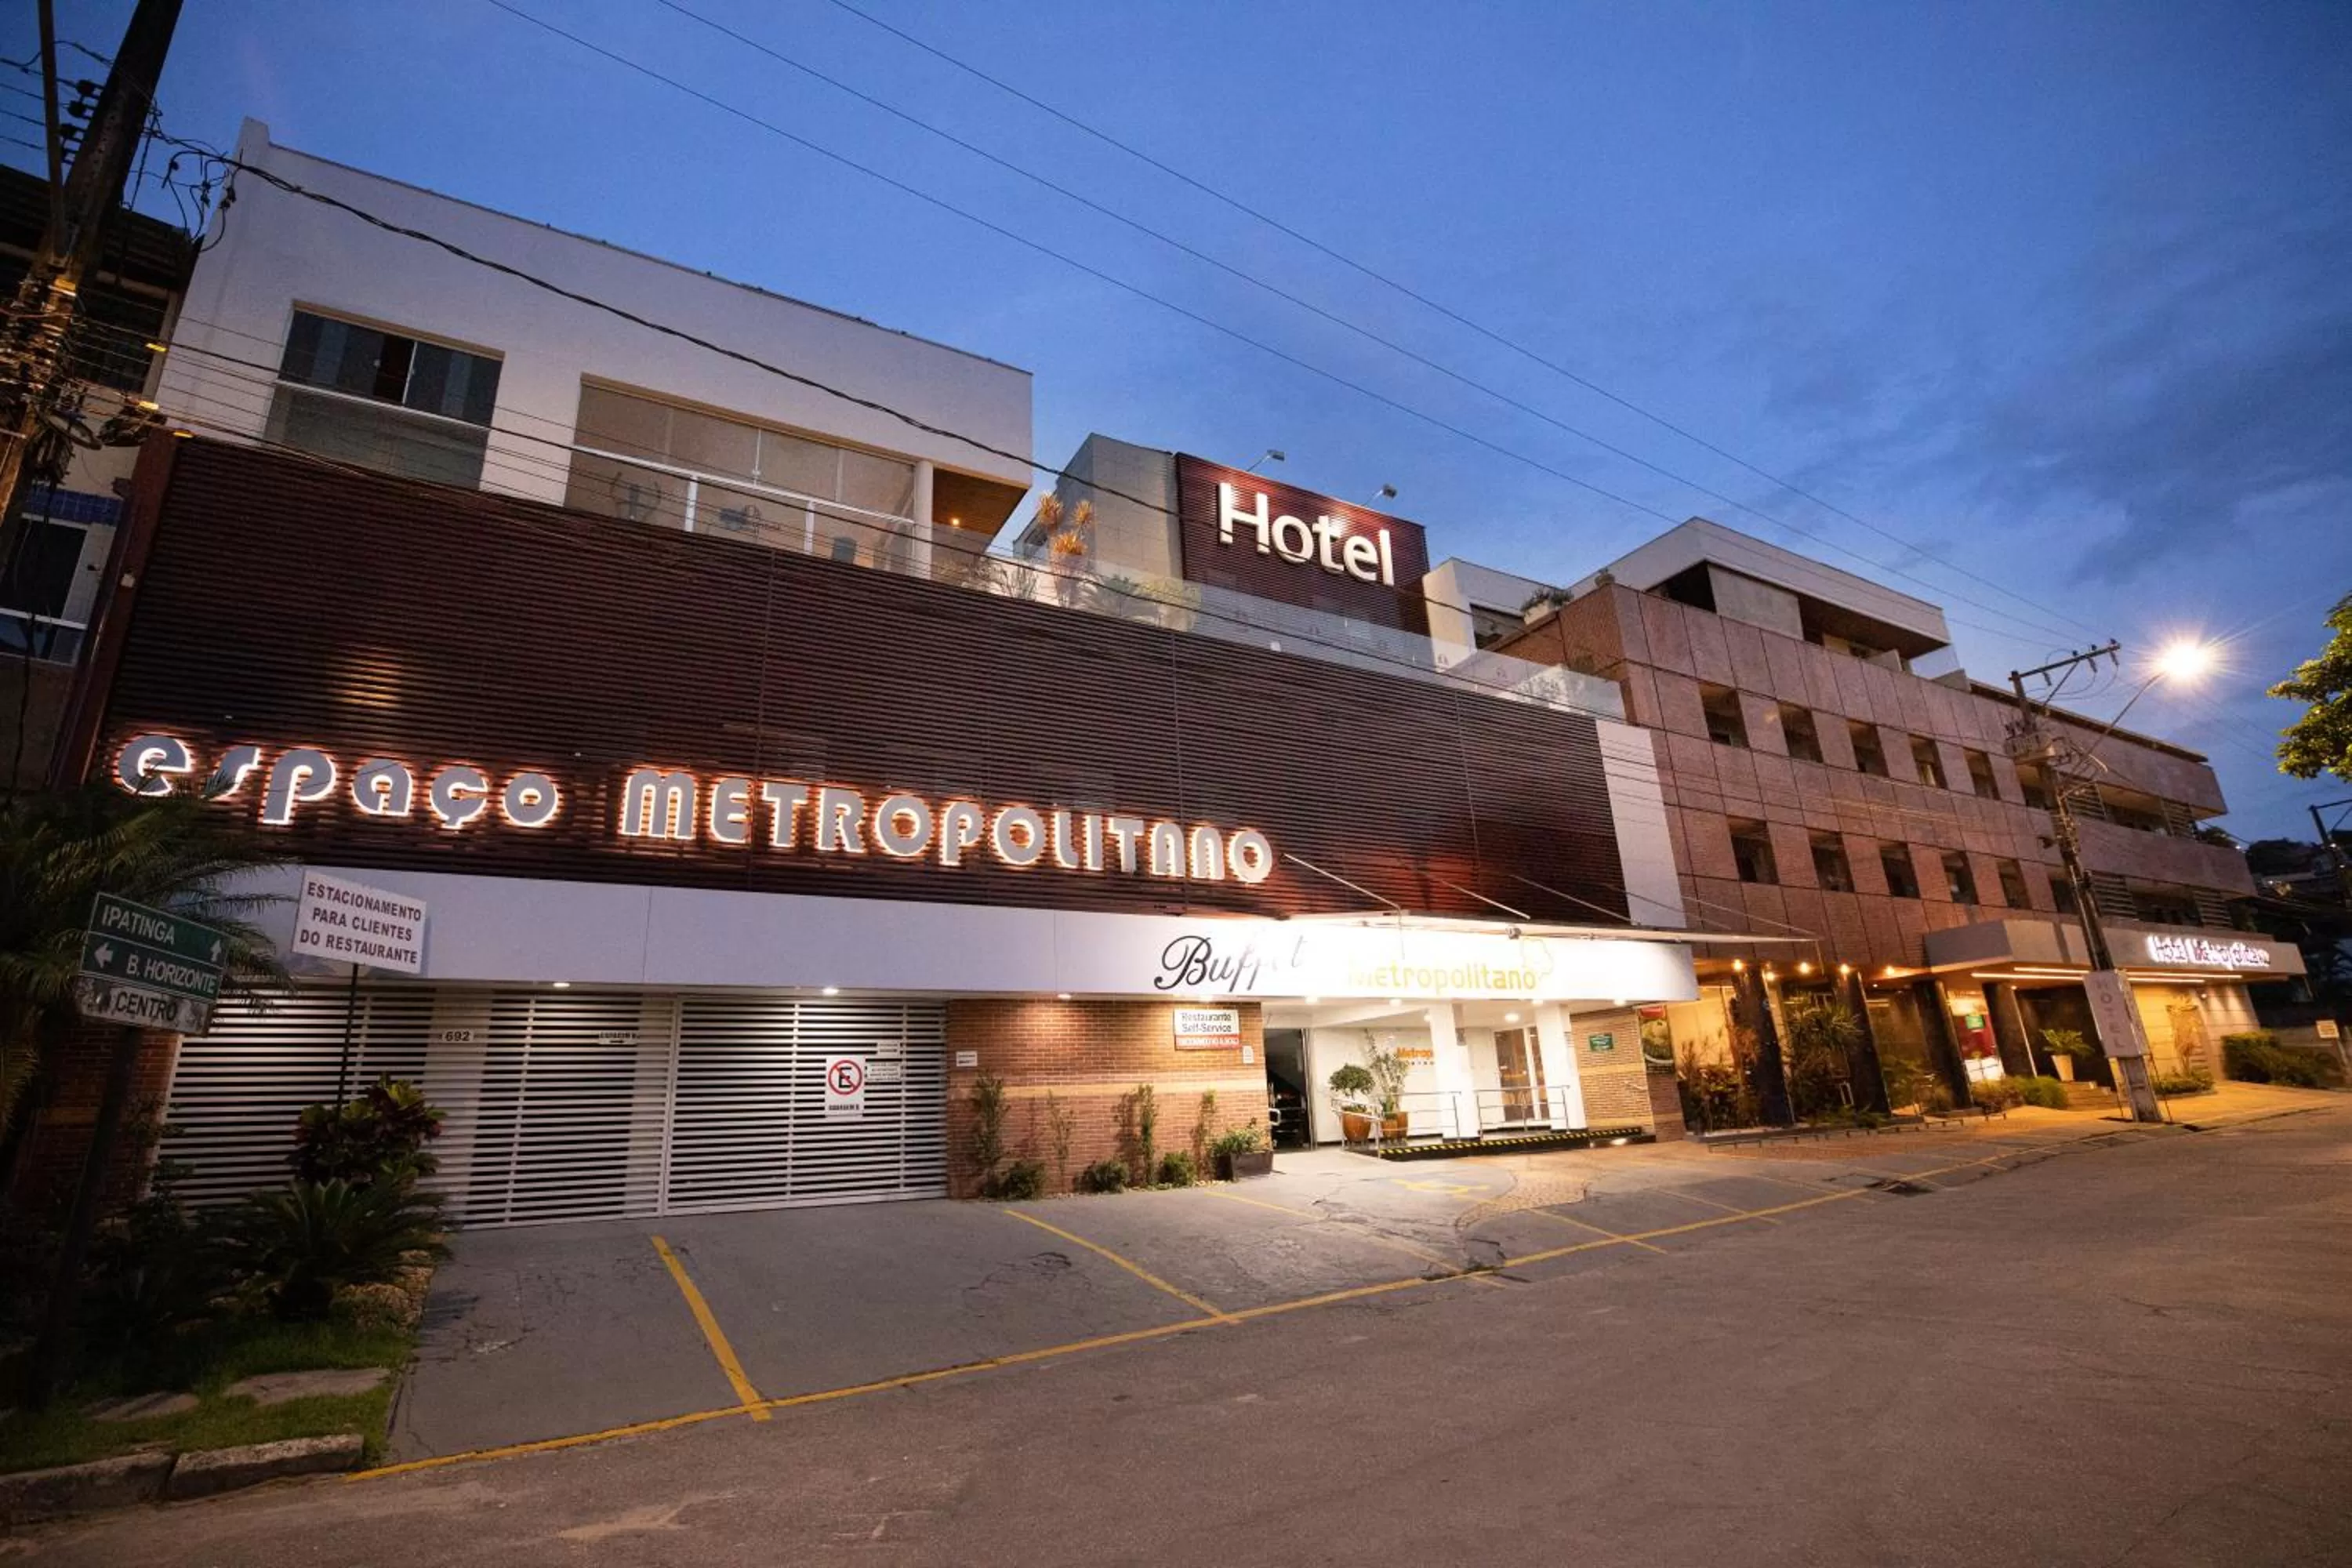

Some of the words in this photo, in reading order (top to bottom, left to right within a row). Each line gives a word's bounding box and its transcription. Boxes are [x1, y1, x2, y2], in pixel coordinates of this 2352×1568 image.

[1218, 482, 1395, 586] Hotel
[117, 735, 560, 829] espaço
[621, 768, 1274, 884] METROPOLITANO
[307, 881, 422, 922] ESTACIONAMENTO
[101, 905, 176, 946] IPATINGA
[313, 906, 348, 929] PARA
[352, 916, 412, 942] CLIENTES
[300, 929, 321, 947] DO
[326, 933, 418, 964] RESTAURANTE
[1154, 935, 1308, 993] Bufft
[126, 955, 140, 975] B.
[144, 957, 217, 994] HORIZONTE
[114, 990, 177, 1022] CENTRO
[1181, 1012, 1232, 1022] Restaurante
[2092, 979, 2125, 1048] HOTEL
[445, 1031, 470, 1042] 692
[1181, 1024, 1232, 1033] Self-Service
